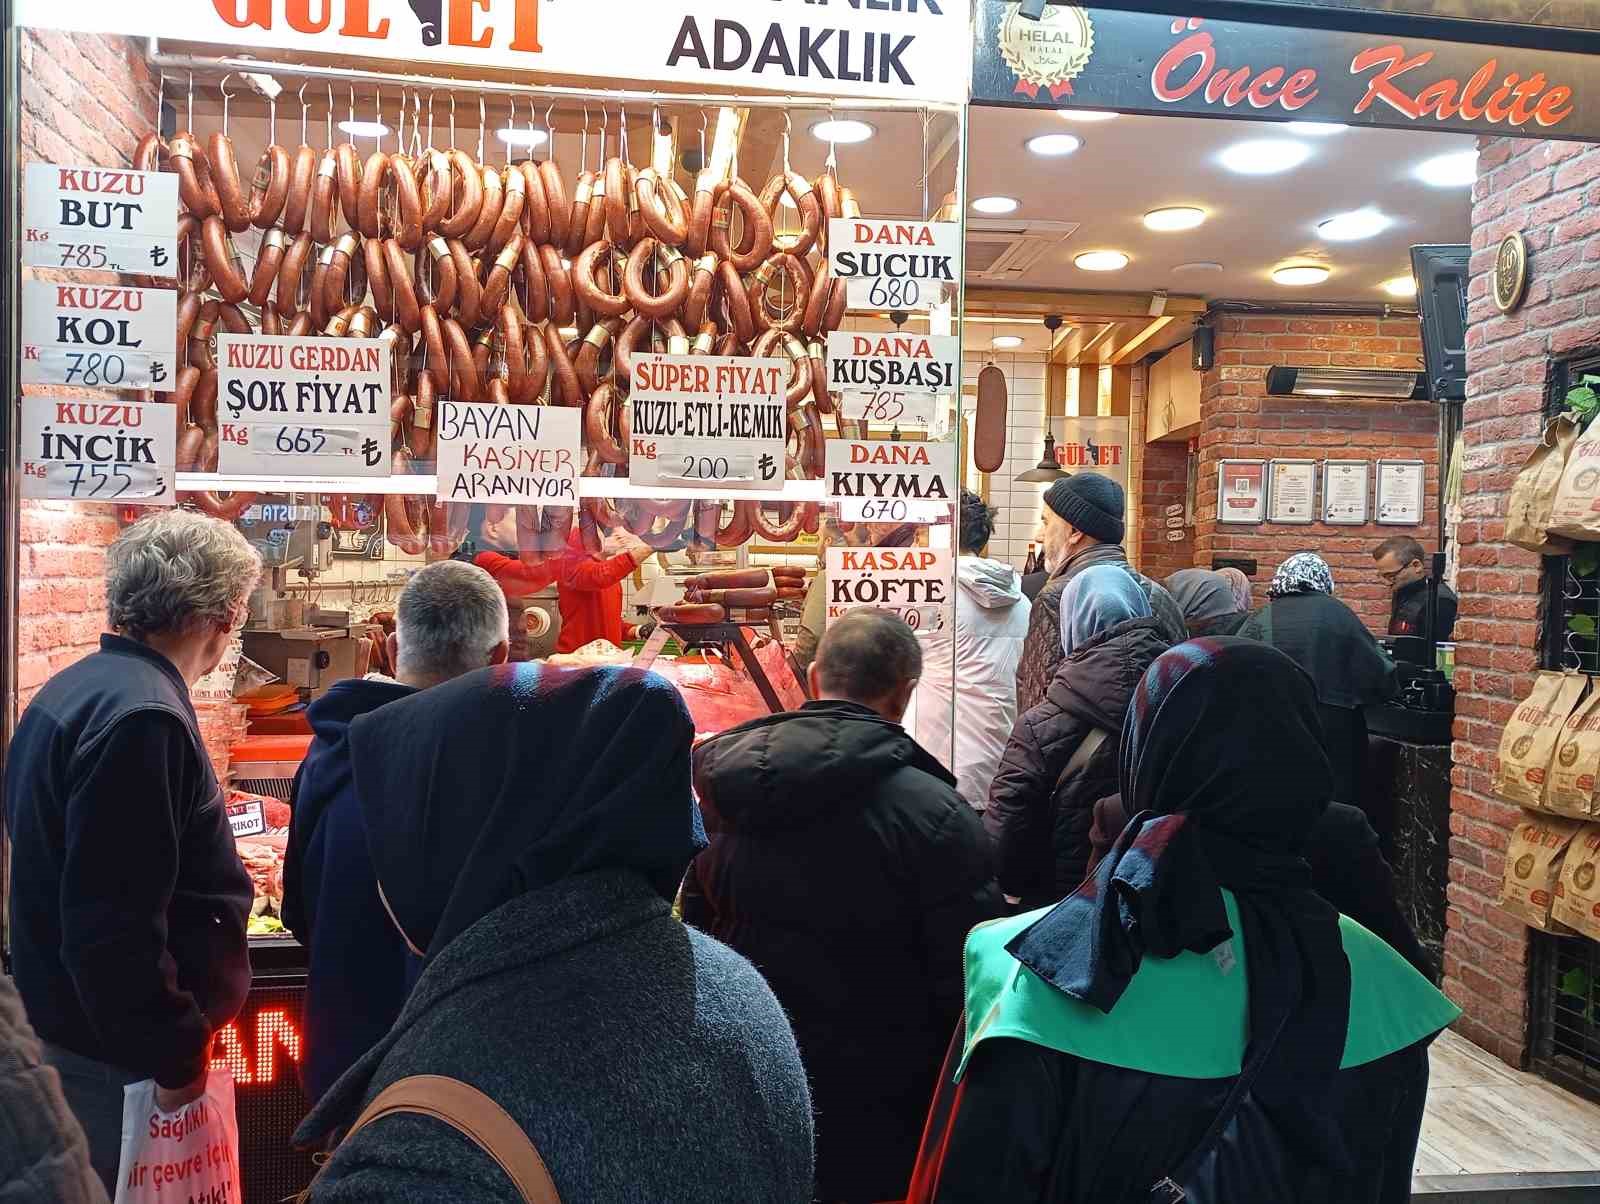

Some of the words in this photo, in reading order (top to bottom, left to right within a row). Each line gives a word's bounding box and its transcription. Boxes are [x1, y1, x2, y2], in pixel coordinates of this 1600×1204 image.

[665, 15, 916, 86] ADAKLIK
[1019, 29, 1074, 44] HELAL
[1151, 17, 1319, 111] Önce
[1349, 44, 1574, 127] Kalite
[58, 168, 145, 195] KUZU
[60, 199, 143, 230] BUT
[853, 223, 936, 246] DANA
[57, 243, 108, 268] 785
[834, 251, 954, 280] SUCUK
[56, 286, 144, 312] KUZU
[869, 276, 920, 309] 680
[56, 316, 143, 348] KOL
[227, 343, 284, 369] KUZU
[289, 346, 380, 372] GERDAN
[852, 335, 934, 359] DANA
[65, 352, 125, 386] 780
[635, 356, 710, 393] SÜPER
[715, 359, 782, 395] FİYAT
[832, 358, 953, 393] KUŞBAŞI
[226, 378, 288, 419] ŞOK
[296, 374, 383, 414] FİYAT
[860, 390, 906, 422] 785
[56, 402, 143, 428] KUZU
[439, 402, 541, 441] BAYAN
[632, 394, 783, 439] KUZU-ETLİ-KEMİK
[40, 426, 156, 464] İNCİK
[222, 424, 249, 445] Kg
[276, 426, 327, 453] 665
[632, 439, 657, 460] Kg
[850, 444, 931, 465] DANA
[1054, 442, 1089, 466] GÜL
[1098, 445, 1122, 466] ET
[24, 462, 48, 478] Kg
[64, 464, 133, 498] 755
[682, 455, 729, 479] 200
[452, 472, 575, 500] ARANIYOR
[831, 472, 949, 499] KIYMA
[861, 499, 907, 521] 670
[842, 552, 937, 571] KASAP
[831, 573, 946, 604] KÖFTE
[153, 1154, 201, 1191] çevre
